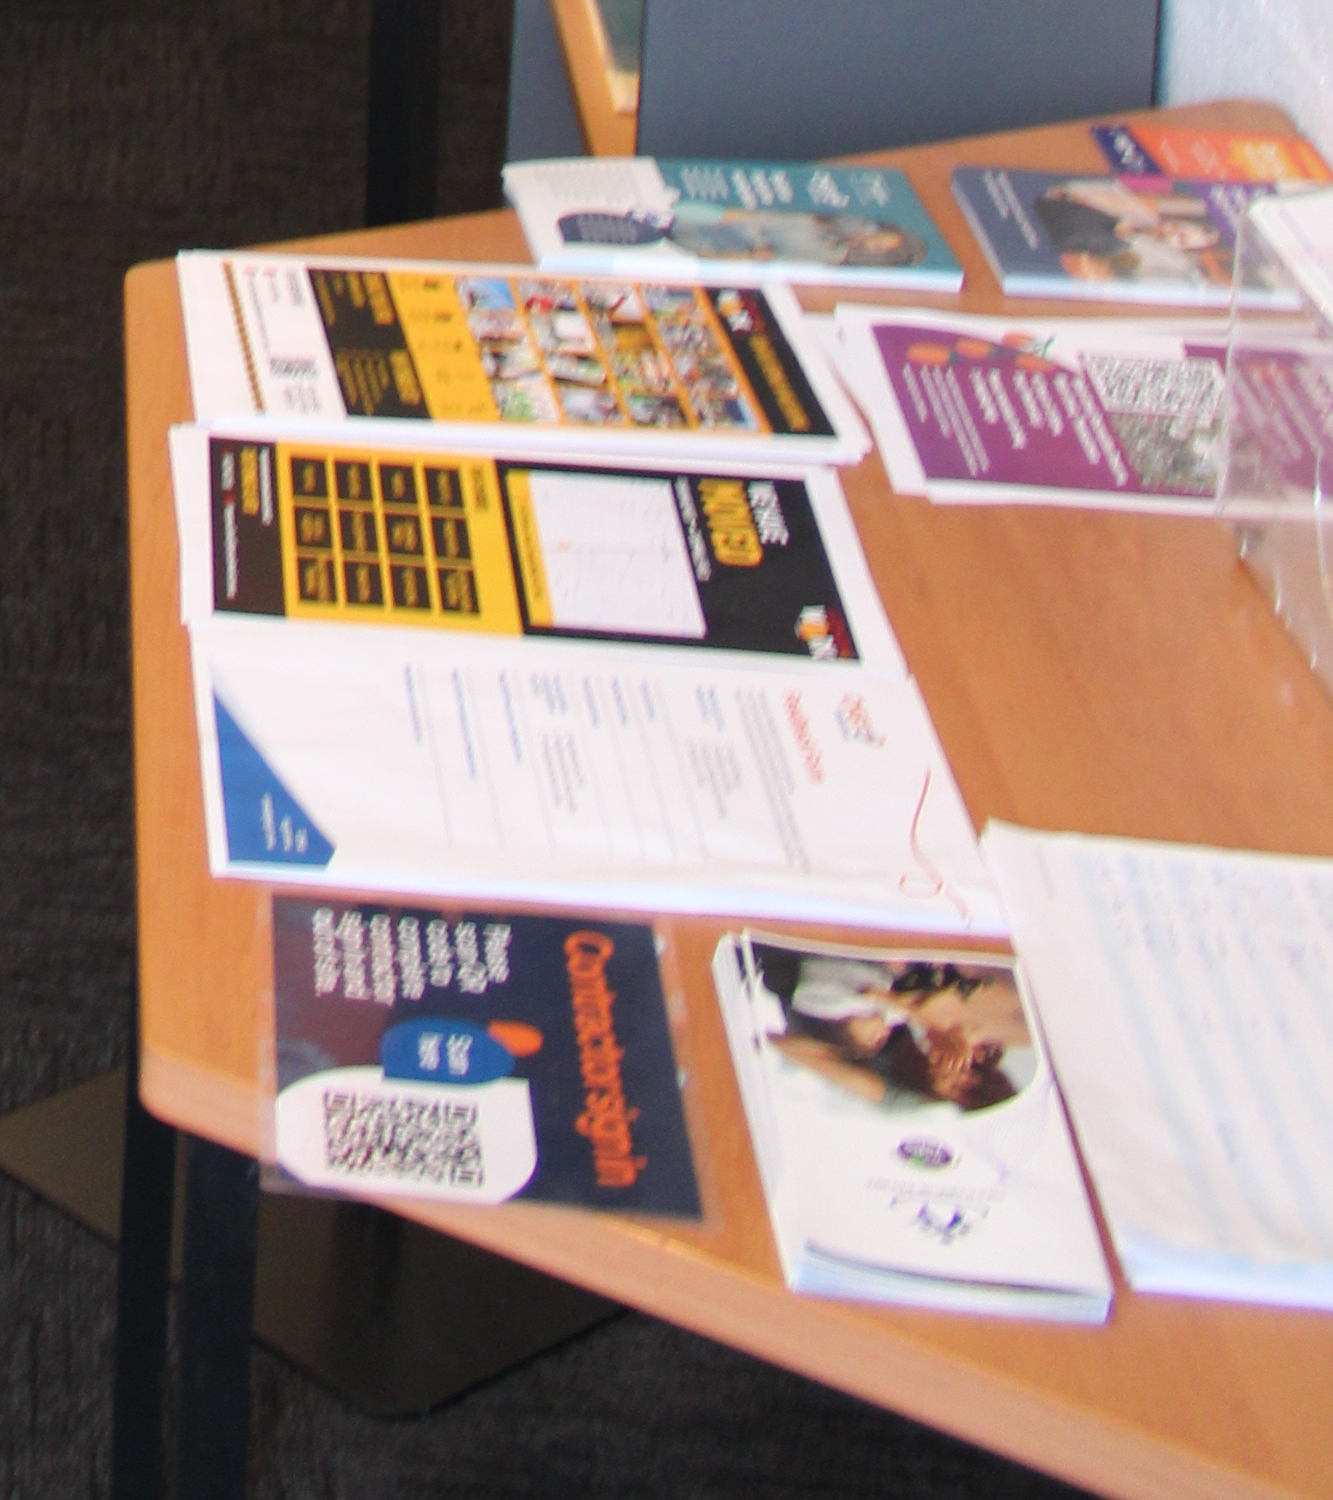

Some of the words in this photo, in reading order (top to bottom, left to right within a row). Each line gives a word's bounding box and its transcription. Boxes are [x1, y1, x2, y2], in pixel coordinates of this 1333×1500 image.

[335, 910, 369, 947] sign
[426, 919, 455, 964] code
[455, 920, 479, 964] scan
[370, 913, 398, 1007] contractor
[397, 916, 428, 1000] complete
[430, 962, 455, 988] to
[483, 922, 512, 984] Please
[344, 962, 373, 1000] and
[458, 962, 489, 994] QR
[564, 930, 626, 1094] Contractor
[418, 1031, 444, 1072] here
[446, 1032, 474, 1076] Scan
[575, 1092, 641, 1156] sign
[595, 1155, 649, 1188] in
